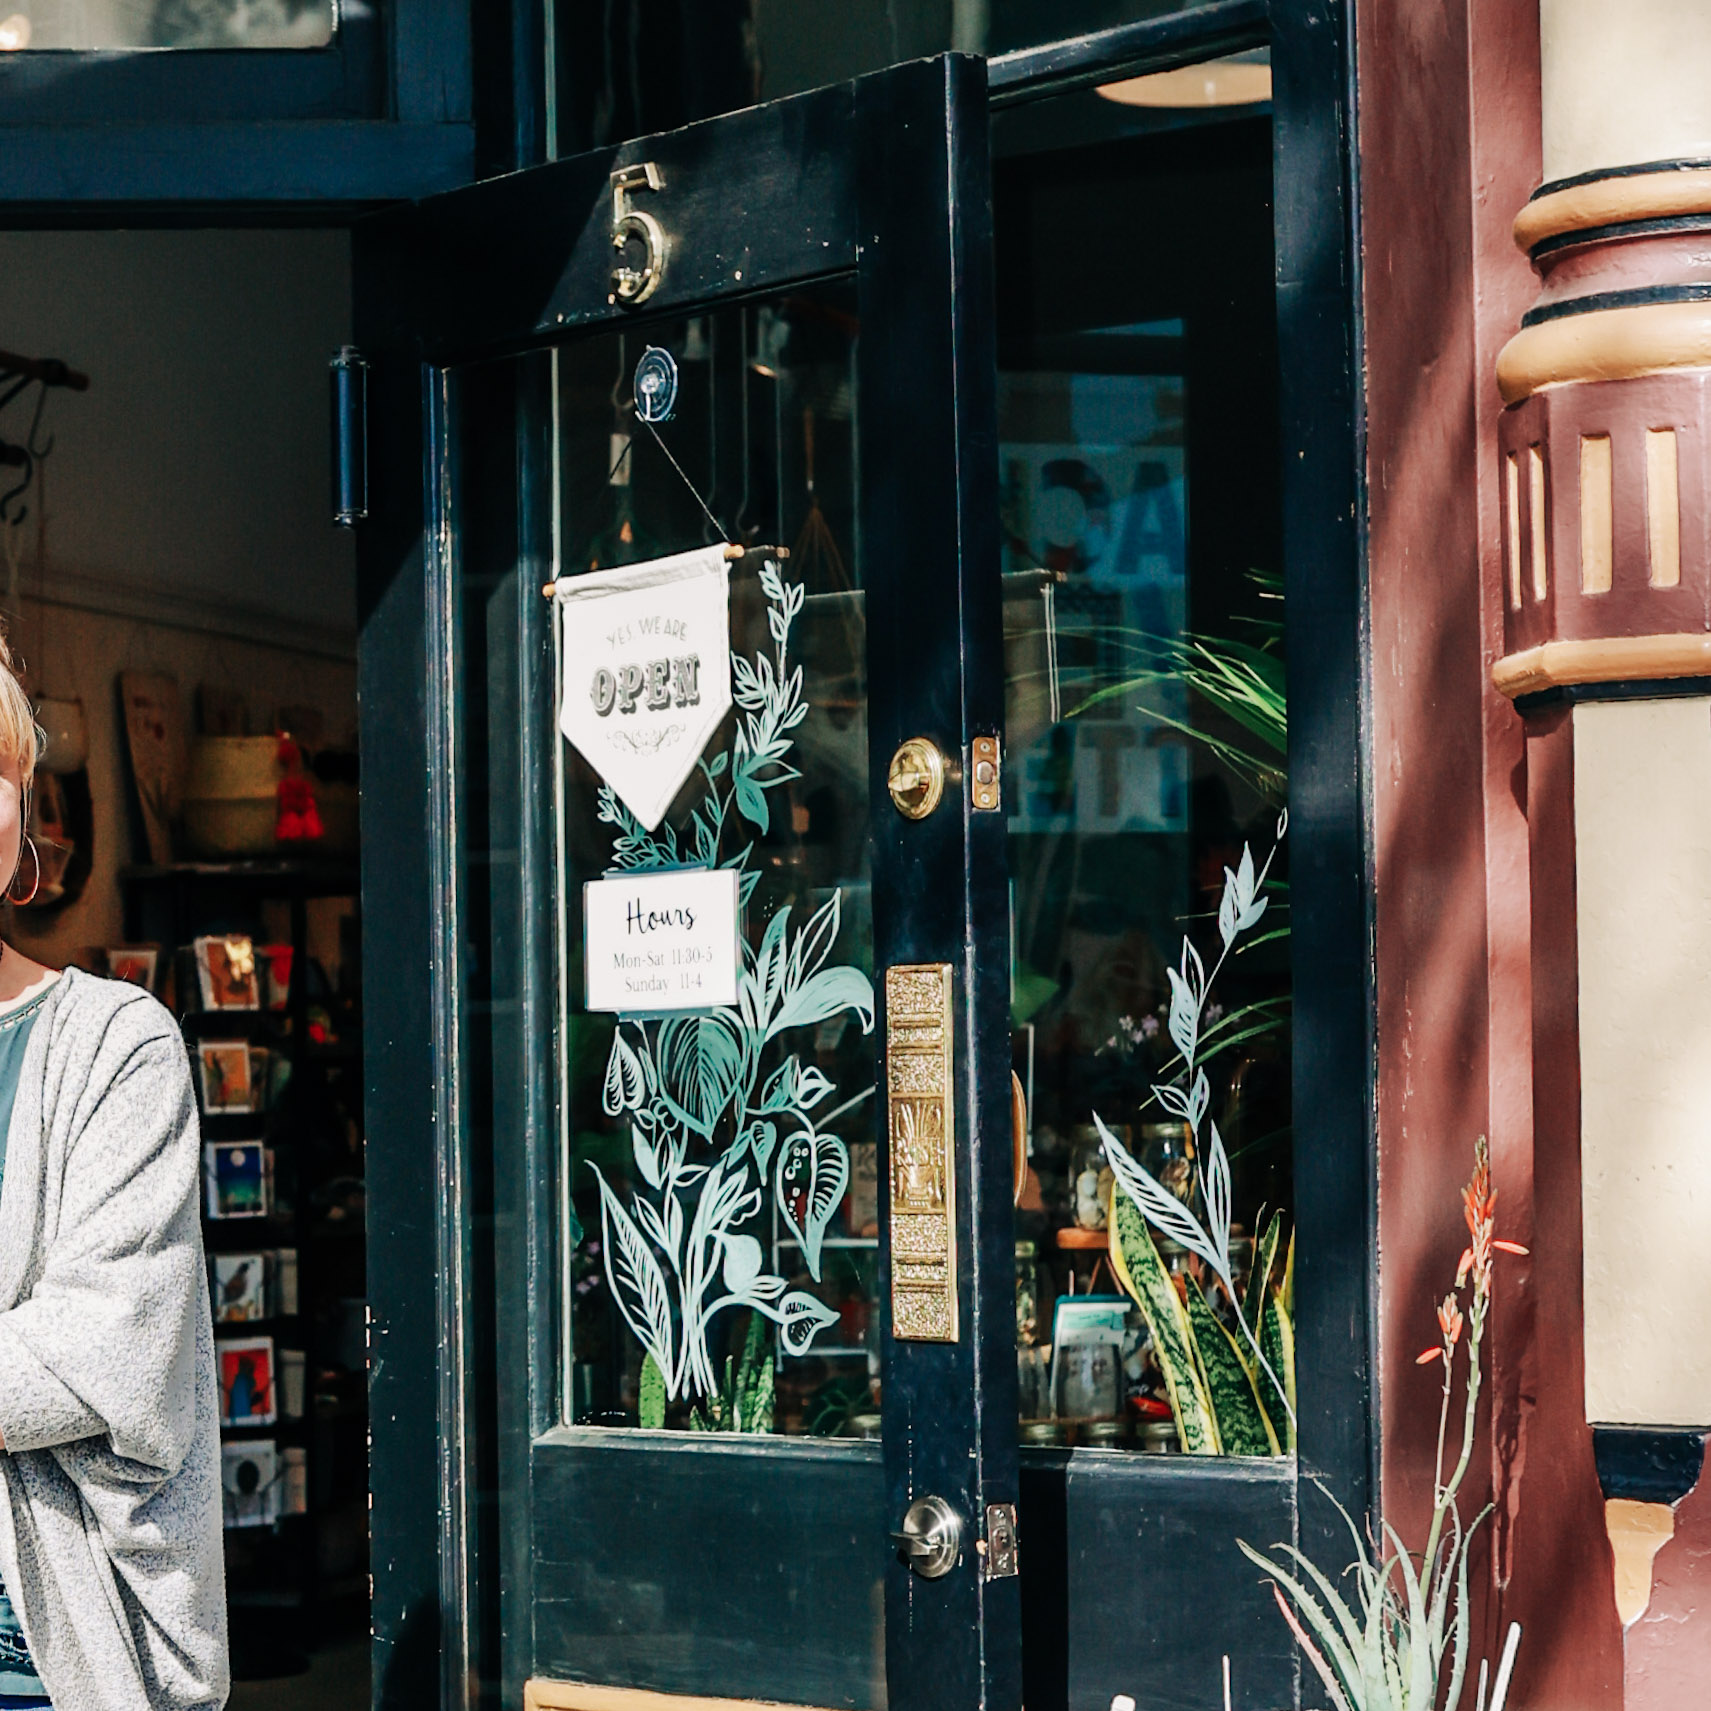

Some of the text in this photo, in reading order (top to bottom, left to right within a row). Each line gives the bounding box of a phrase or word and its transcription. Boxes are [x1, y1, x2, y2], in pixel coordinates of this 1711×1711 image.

[608, 161, 667, 305] 5
[638, 615, 662, 635] WE
[663, 617, 688, 642] ARE
[590, 653, 700, 717] OPEN
[626, 896, 697, 935] Hours
[613, 949, 665, 970] Mon-Sat
[625, 972, 703, 996] Sunday 11-4
